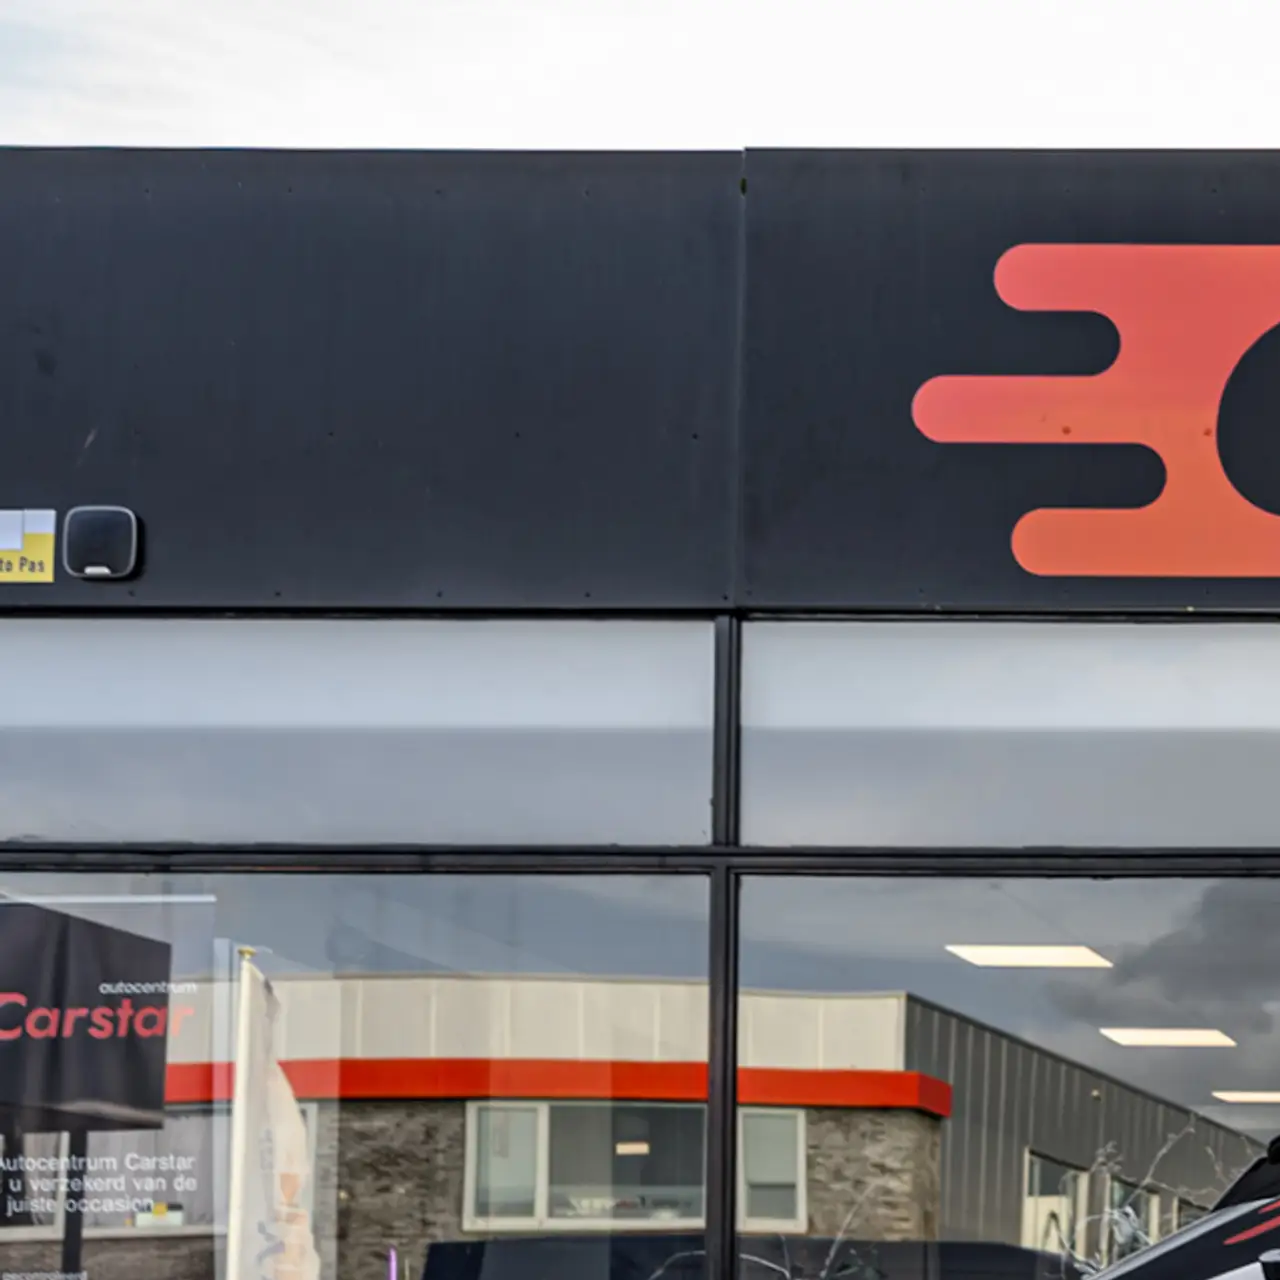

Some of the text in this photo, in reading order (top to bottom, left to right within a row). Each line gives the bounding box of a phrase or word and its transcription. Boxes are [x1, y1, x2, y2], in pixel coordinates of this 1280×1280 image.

[124, 1153, 197, 1171] Carstar
[29, 1175, 126, 1192] verzekerd
[131, 1179, 168, 1192] van
[173, 1175, 198, 1192] de
[65, 1194, 155, 1213] occasion
